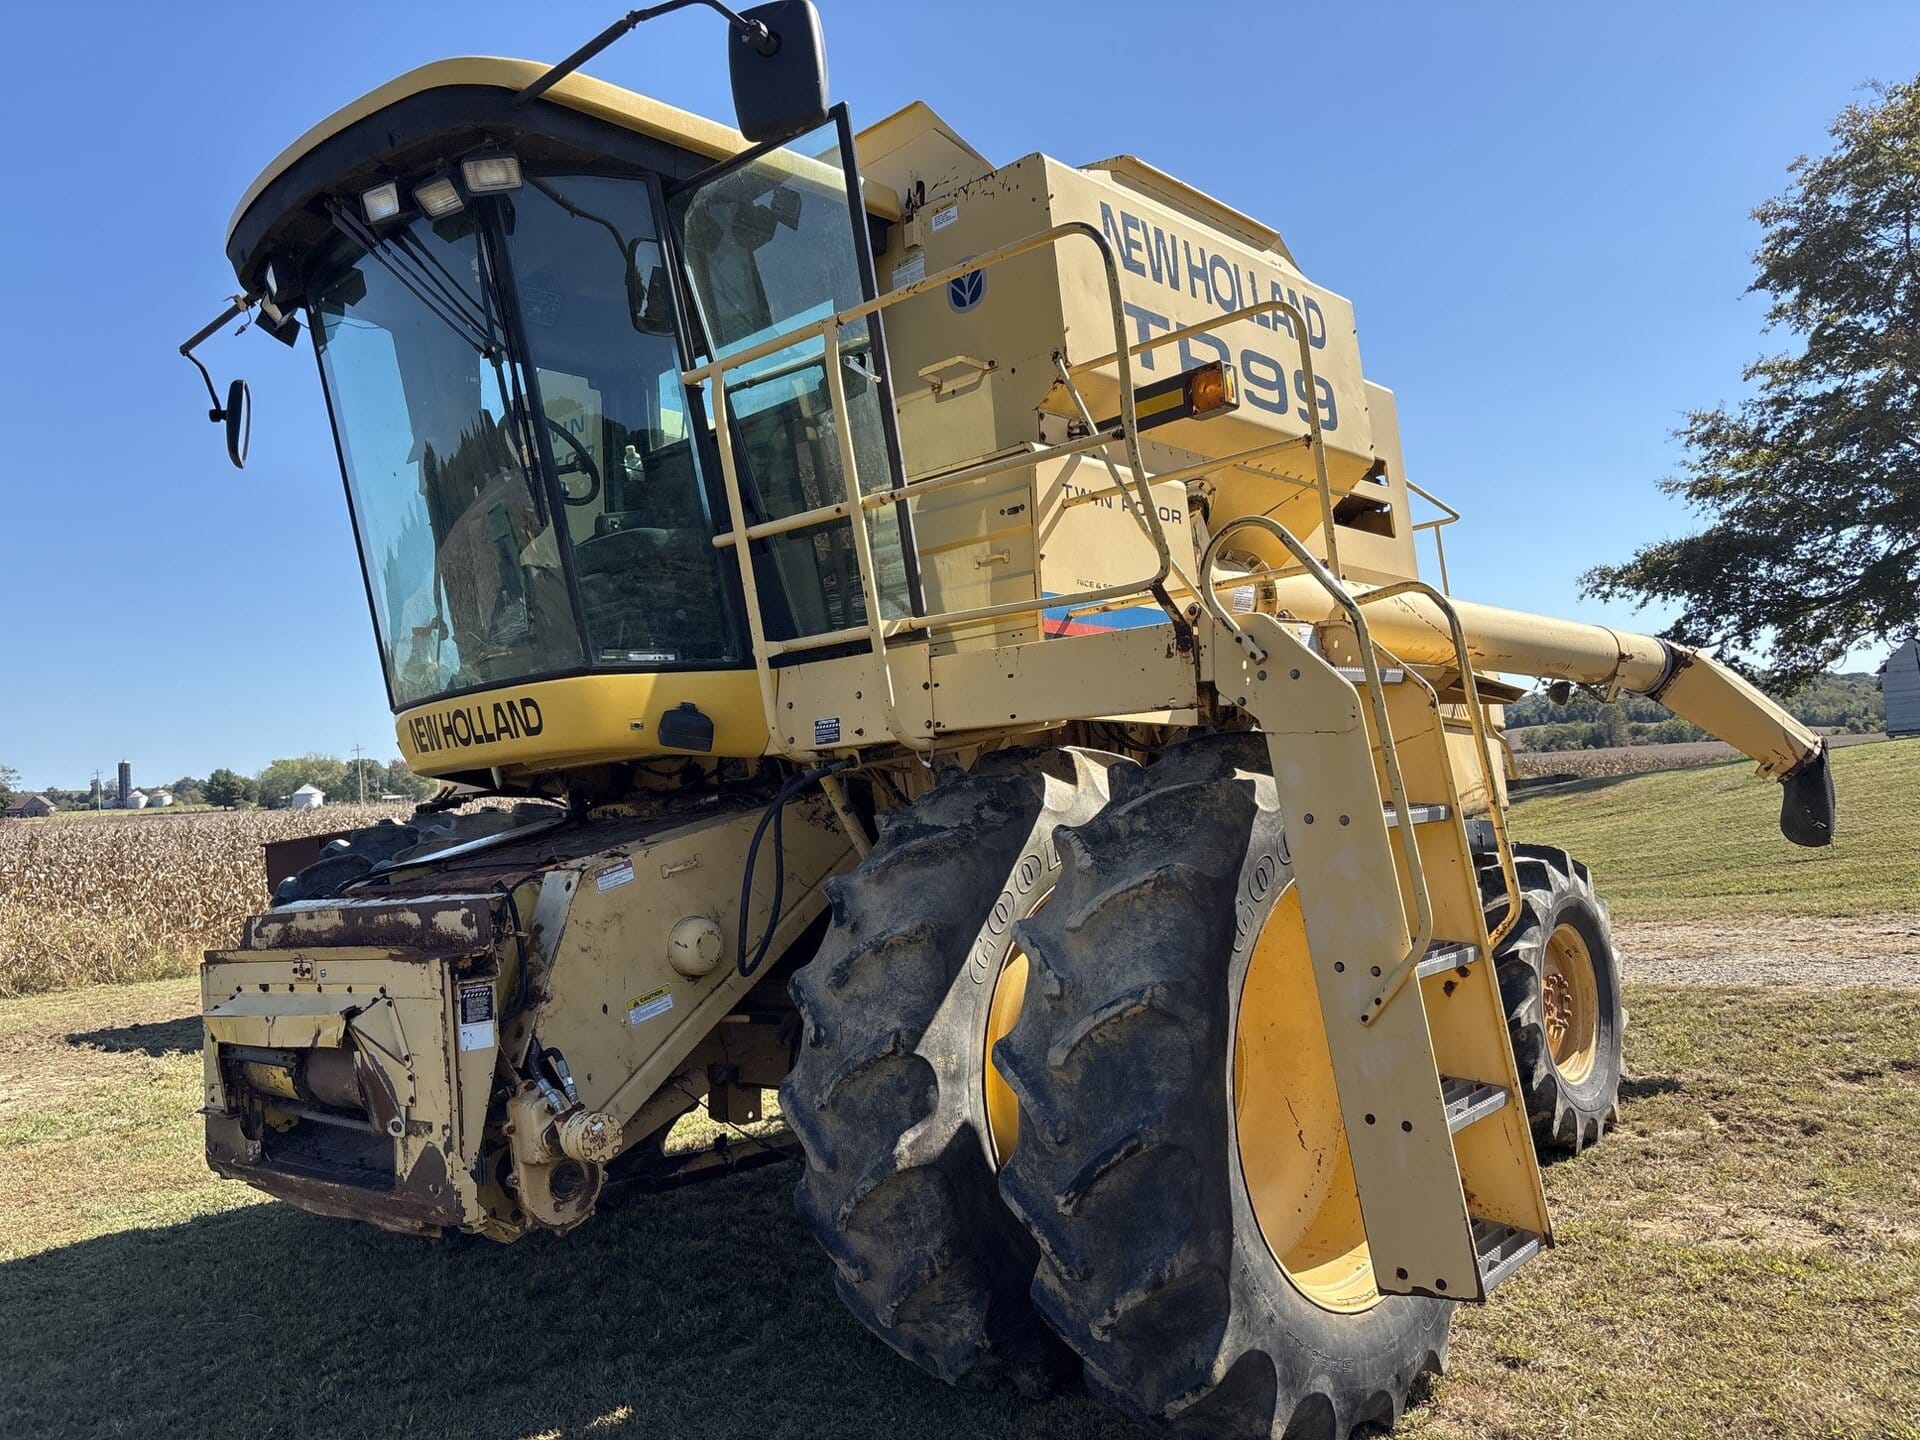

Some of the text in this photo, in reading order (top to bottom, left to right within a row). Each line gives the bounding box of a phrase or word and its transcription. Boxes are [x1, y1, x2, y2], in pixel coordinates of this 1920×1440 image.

[1099, 200, 1327, 350] NEW HOLLAND
[1121, 498, 1182, 525] ROOR
[408, 697, 544, 754] NEW HOLLAND
